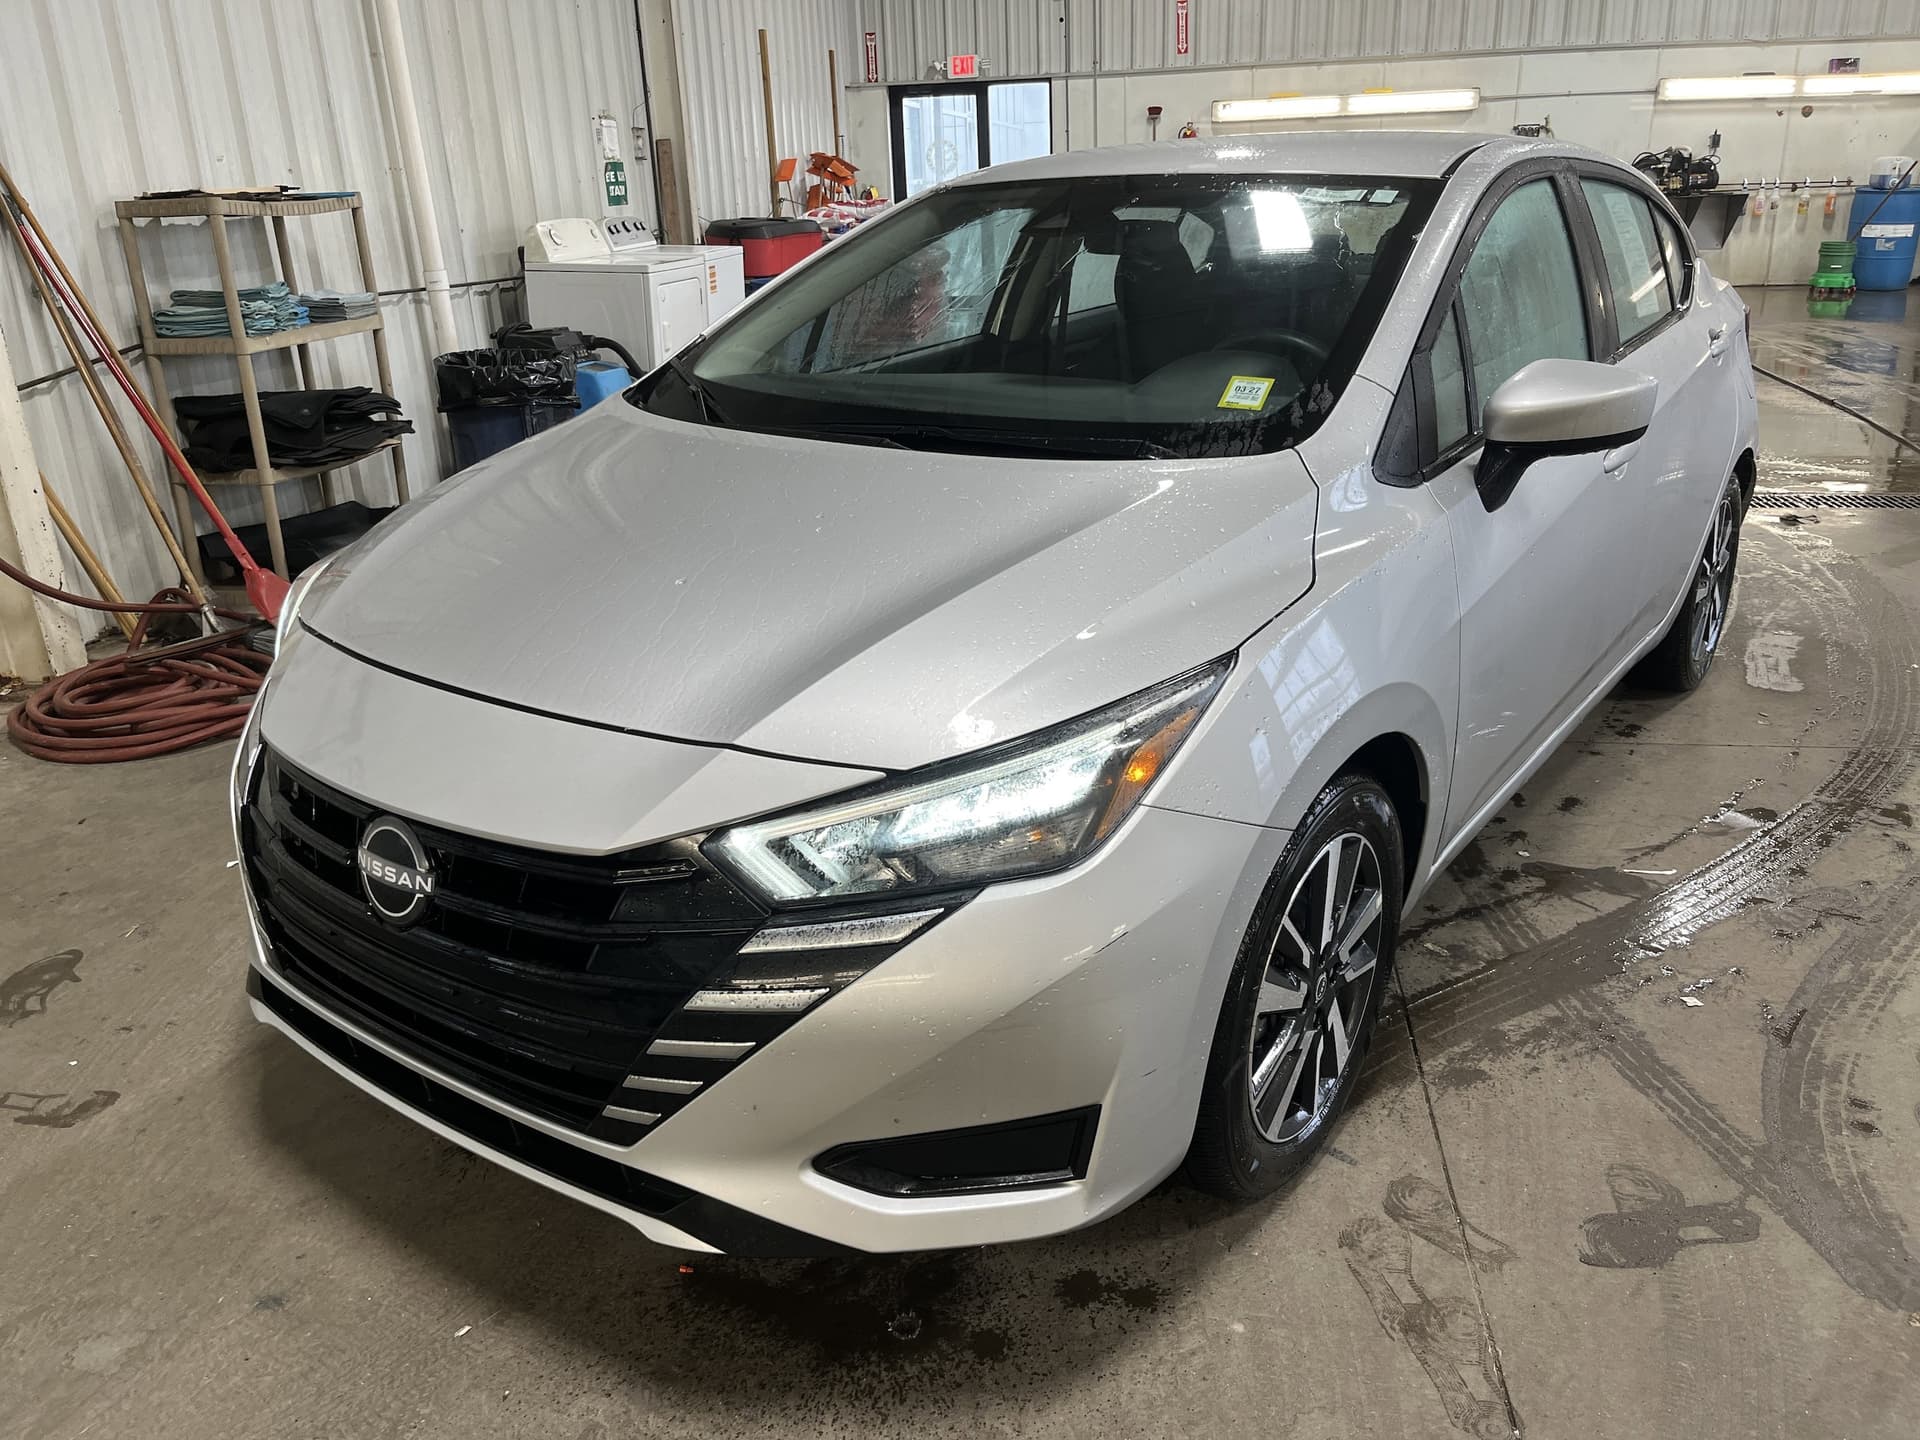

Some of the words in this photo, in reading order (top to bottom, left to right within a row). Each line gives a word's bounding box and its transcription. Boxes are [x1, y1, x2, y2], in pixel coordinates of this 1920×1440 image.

[953, 55, 974, 75] EXIT
[1234, 385, 1247, 393] 03
[1248, 386, 1262, 394] 27
[357, 849, 433, 893] NISSAN
